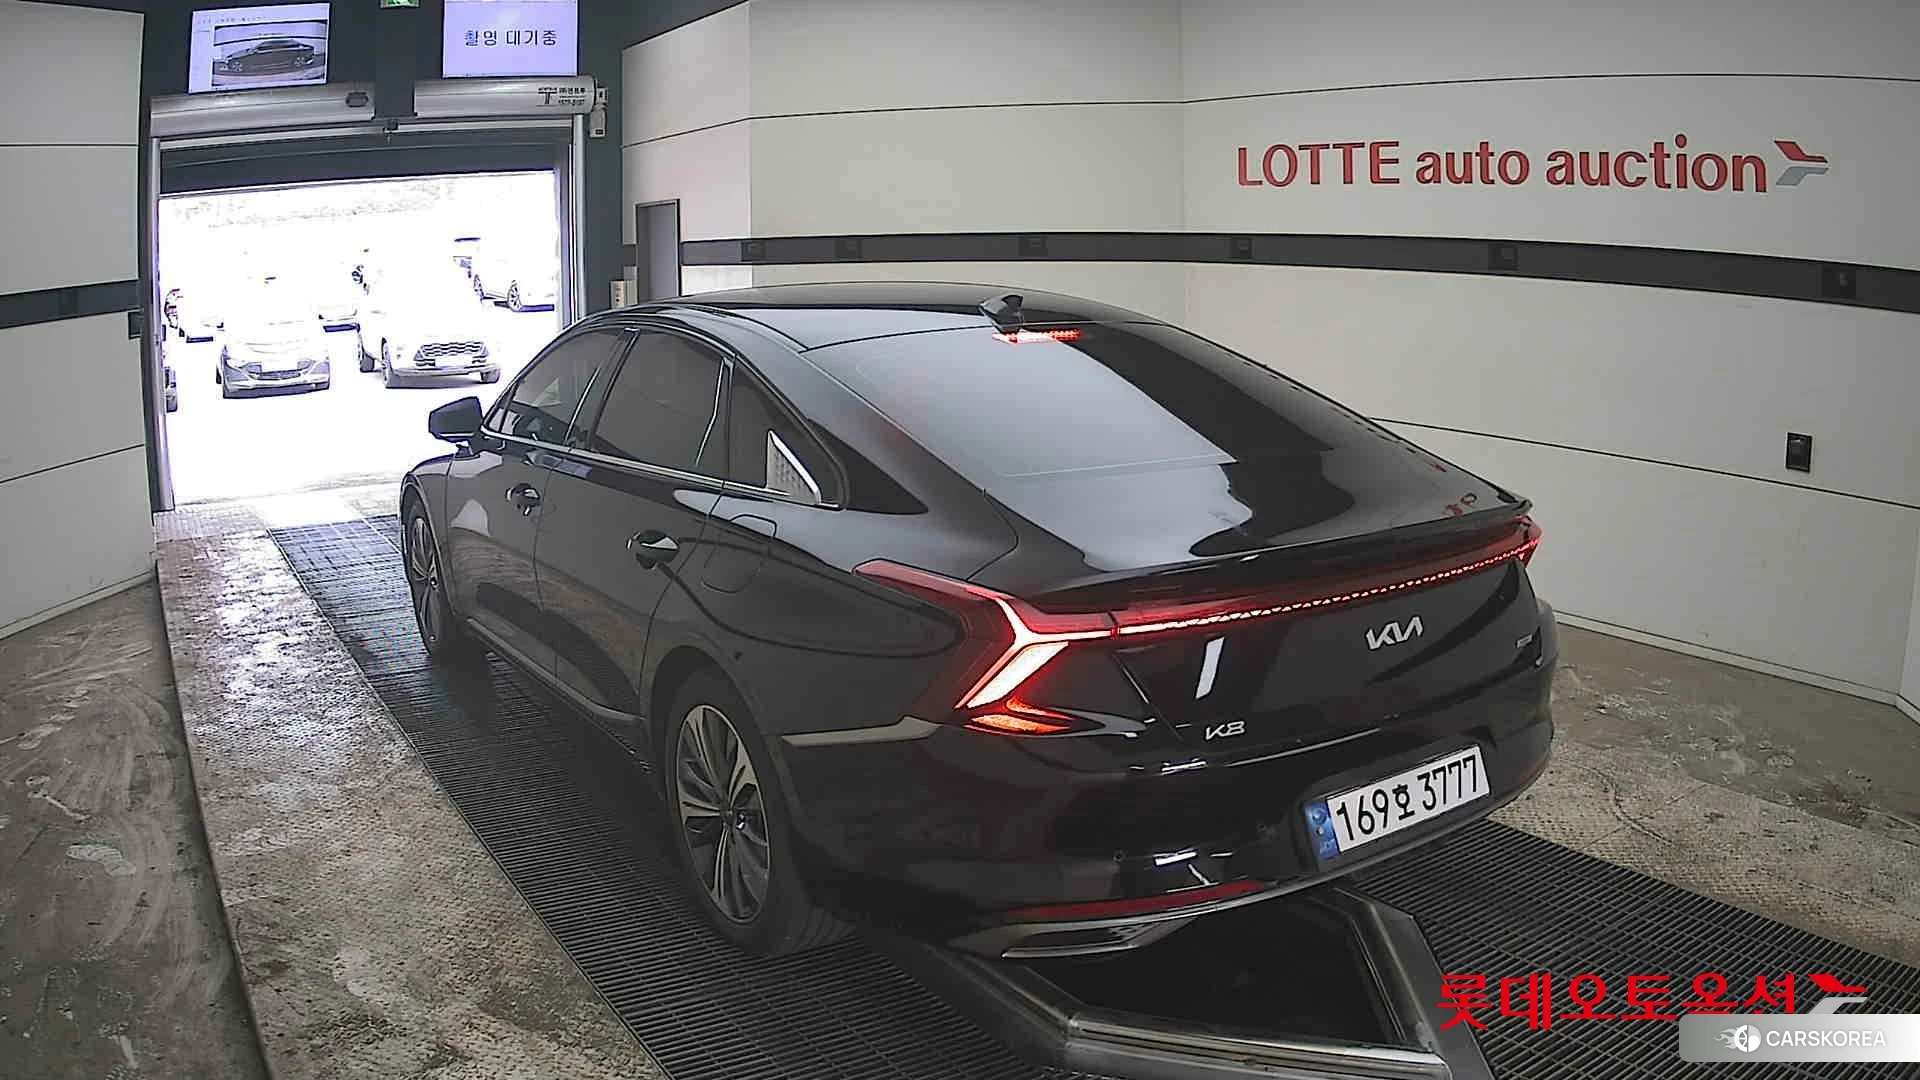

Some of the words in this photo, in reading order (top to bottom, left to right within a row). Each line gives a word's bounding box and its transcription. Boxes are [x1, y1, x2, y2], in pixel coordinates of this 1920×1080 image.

[1238, 141, 1400, 187] LOTTE
[1415, 141, 1530, 185] auto
[1546, 134, 1767, 192] auction
[1366, 616, 1423, 650] KIA
[1205, 720, 1245, 740] K8
[1336, 784, 1415, 841] 169호
[1417, 754, 1477, 811] 3777
